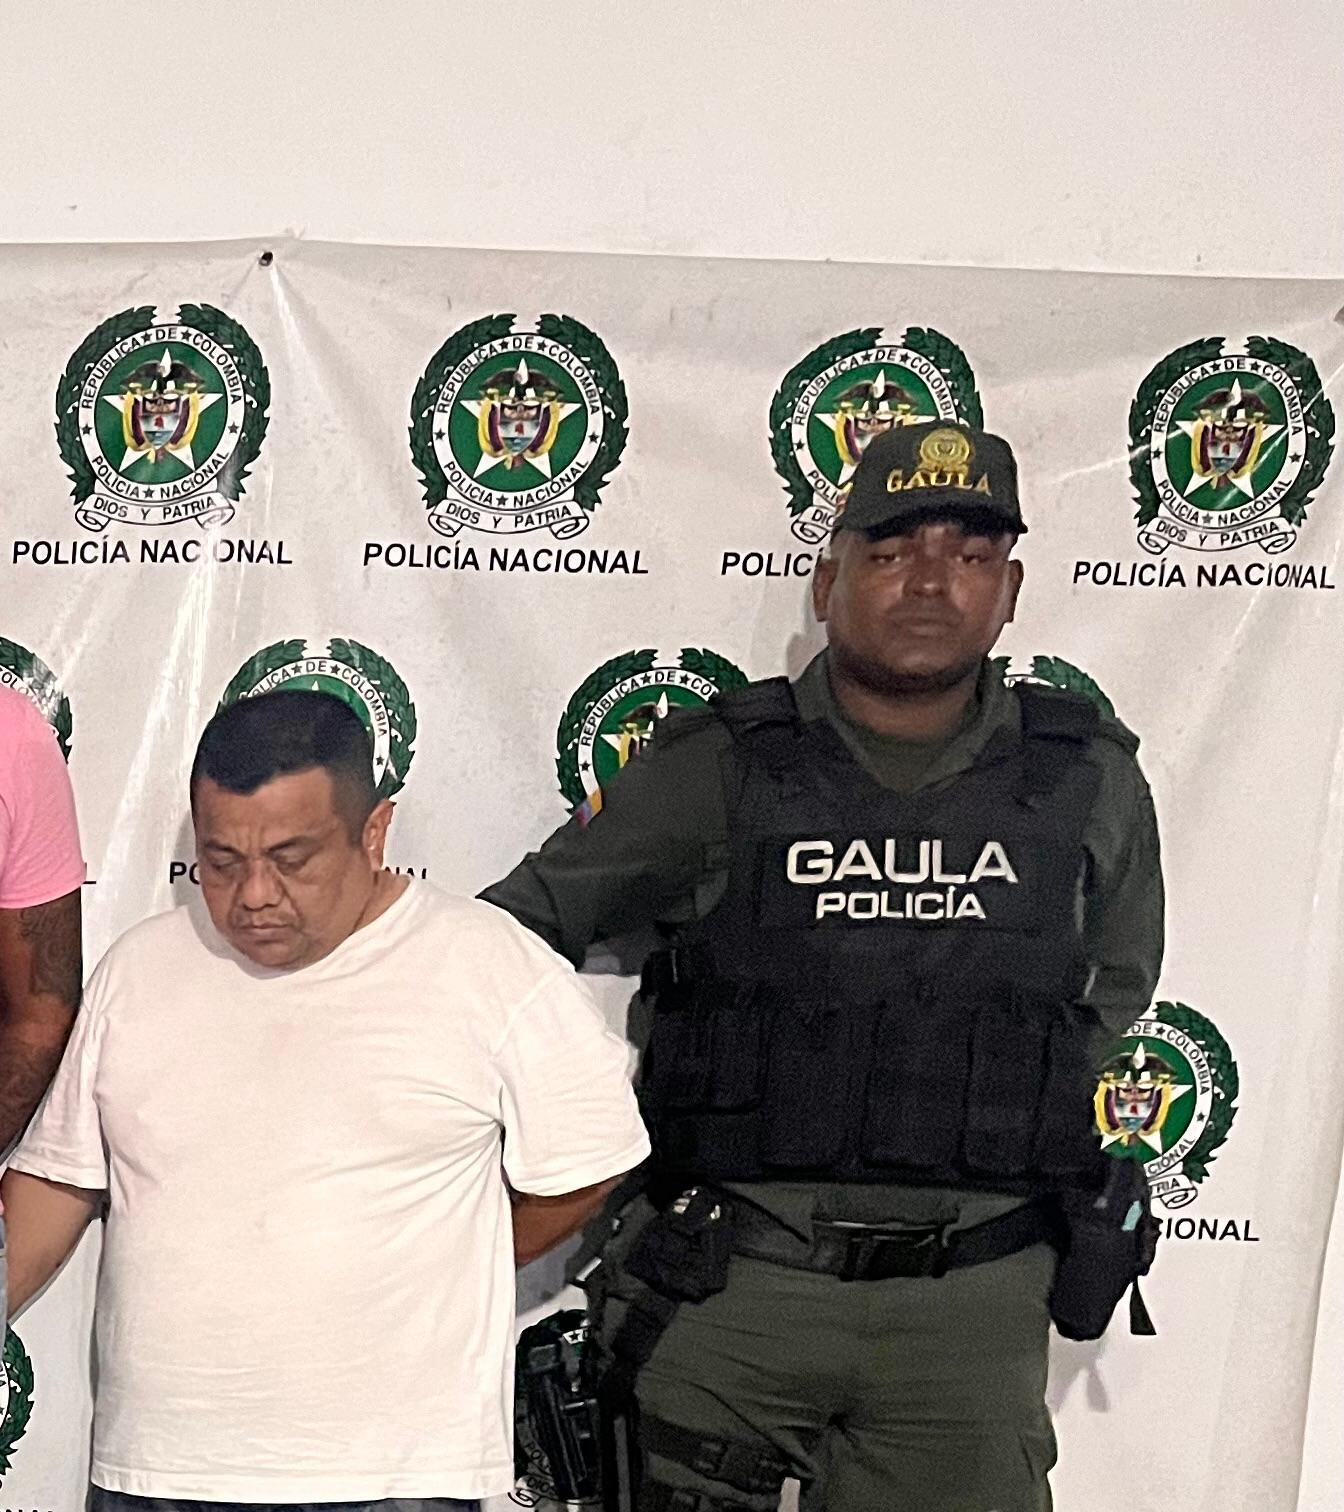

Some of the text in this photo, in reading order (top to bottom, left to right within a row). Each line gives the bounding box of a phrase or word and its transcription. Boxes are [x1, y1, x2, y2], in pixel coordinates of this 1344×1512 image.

[513, 339, 534, 349] DE
[549, 345, 600, 415] COLOMBIA
[874, 351, 897, 360] DE
[910, 357, 953, 417] COLOMBI
[1225, 359, 1245, 369] DE
[1261, 364, 1319, 431] COLOMBIA
[444, 461, 493, 505] POLICIA
[886, 468, 992, 497] GAULA
[445, 503, 572, 527] DIOS PATRIA
[1158, 479, 1201, 523] POLICIA
[11, 534, 293, 563] POLICÍA NACONAL
[1156, 521, 1273, 545] DIOS PATRIA
[364, 540, 649, 575] POLICÍA NACIONAL
[721, 551, 818, 576] POLIC
[1073, 557, 1336, 590] POLICÍA NACIONAL
[786, 838, 1018, 884] GAULA
[815, 885, 986, 920] POLICÍA
[1166, 1030, 1210, 1095] COLOMBIA
[1147, 1139, 1196, 1176] CIONAL
